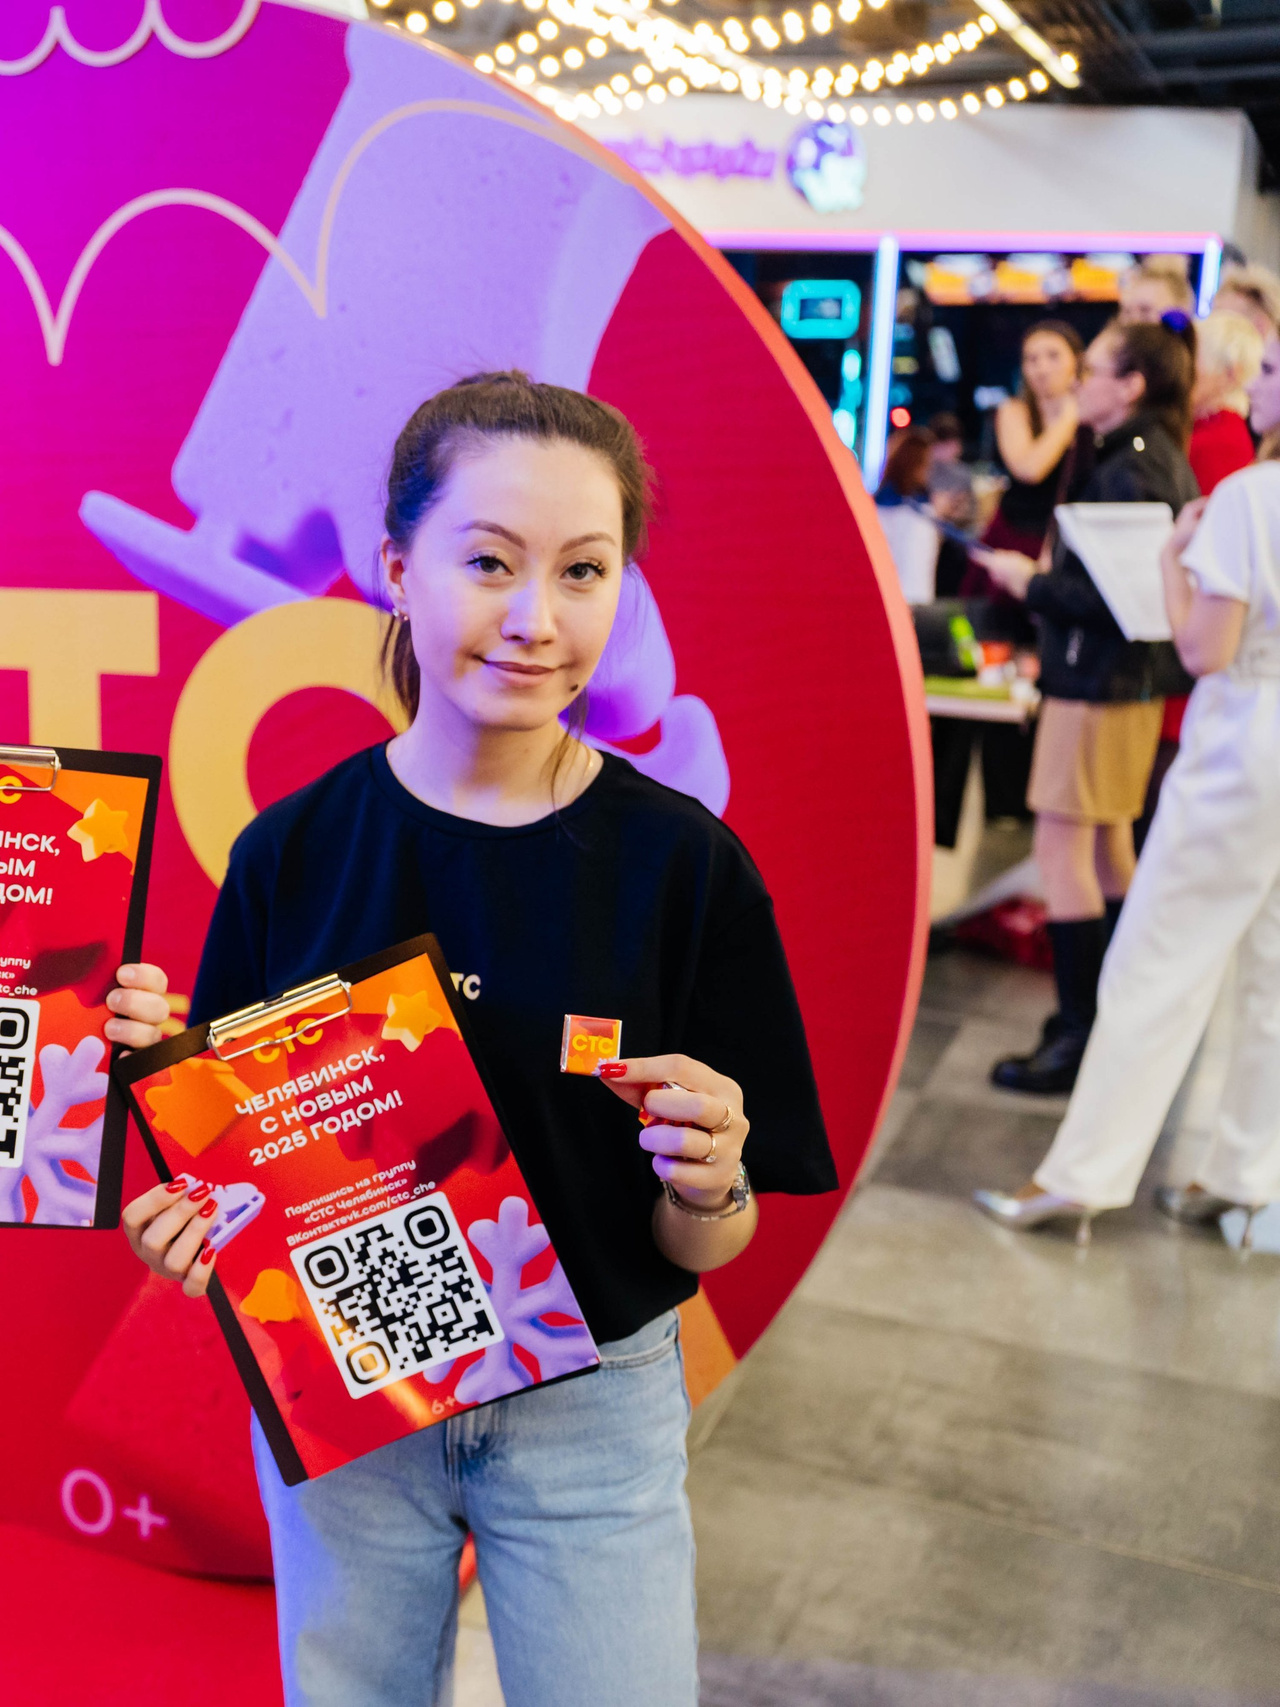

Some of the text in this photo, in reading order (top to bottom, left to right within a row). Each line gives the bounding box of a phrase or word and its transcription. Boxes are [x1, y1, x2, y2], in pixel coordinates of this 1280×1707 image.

[449, 972, 482, 1001] ТС
[252, 1017, 324, 1064] СТС
[572, 1034, 614, 1054] СТС
[234, 1046, 386, 1116] ЧЕЛЯБИНСК,
[260, 1075, 374, 1134] С НОВЫМ
[249, 1089, 404, 1166] 2025 ГОДОМ!
[284, 1160, 417, 1218] Подпишись на группу
[336, 1178, 408, 1209] Челябинск»
[431, 1395, 456, 1415] 6+
[60, 1468, 169, 1538] 0+
